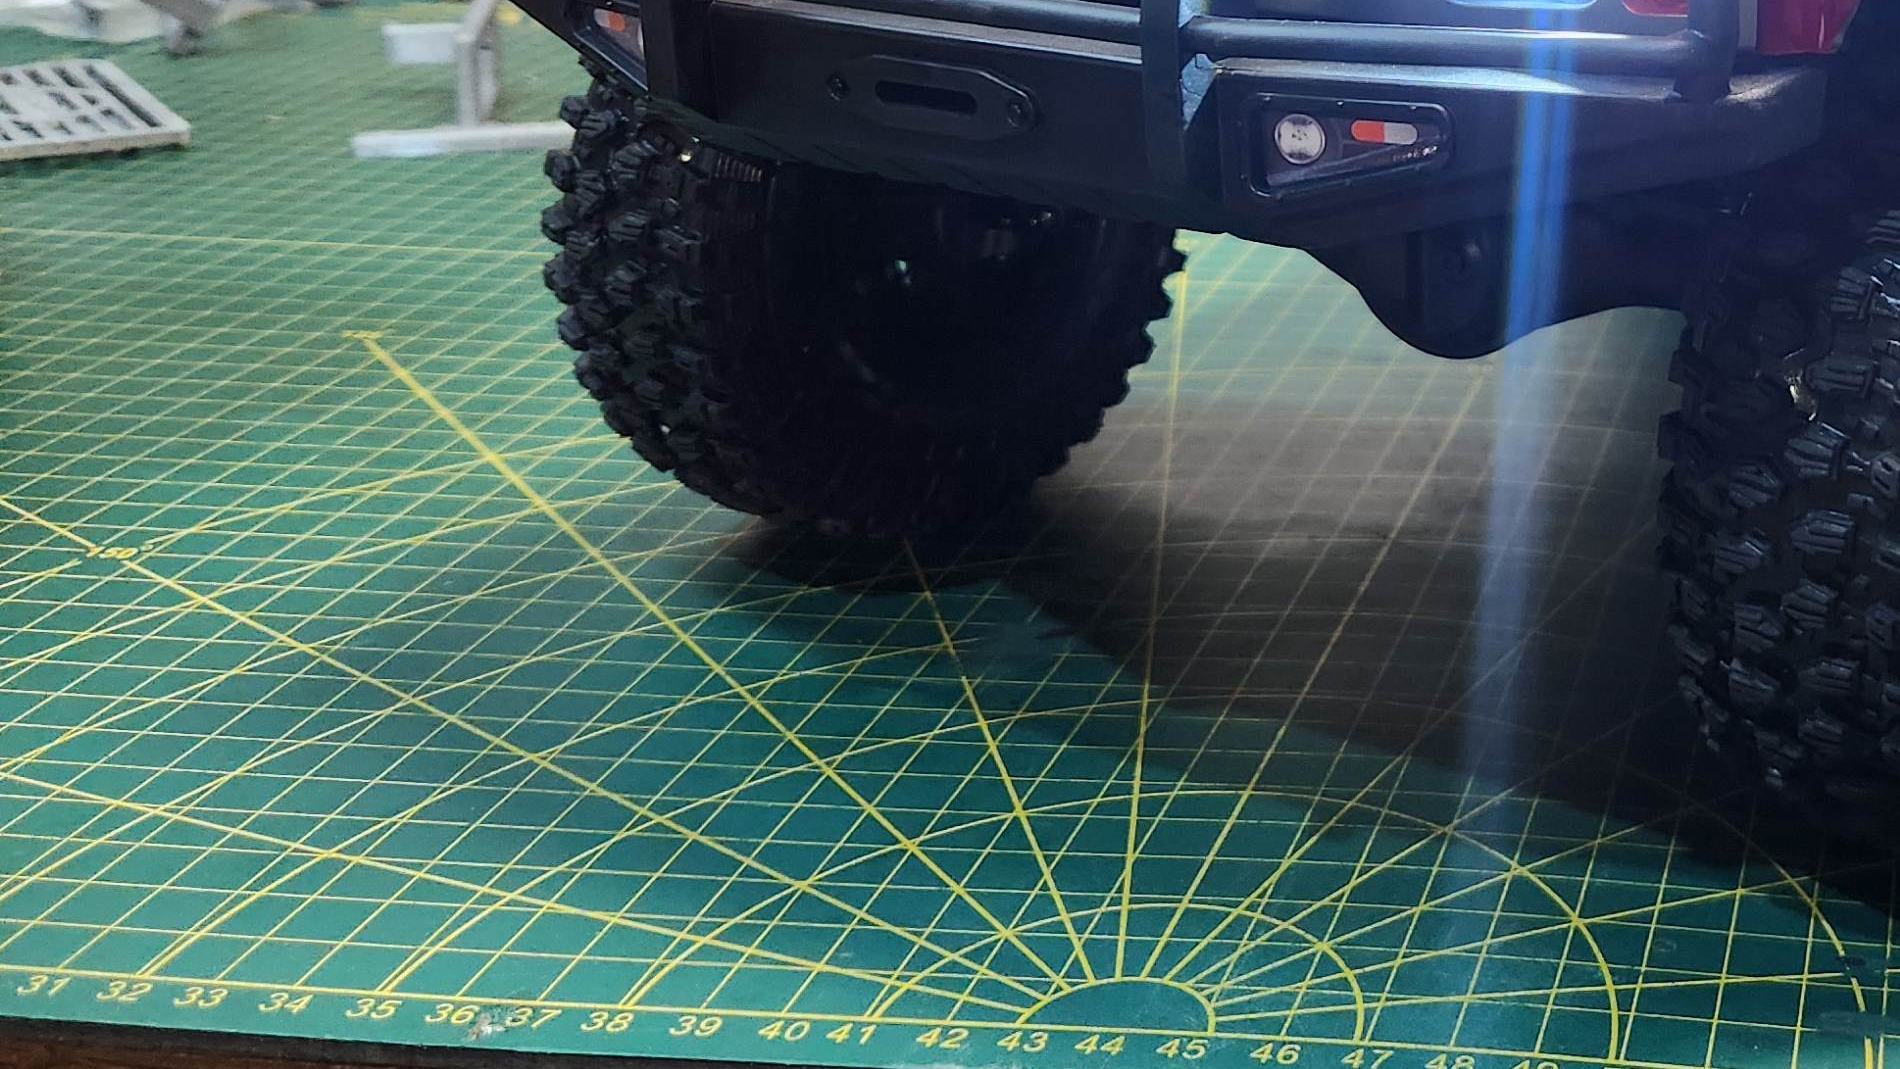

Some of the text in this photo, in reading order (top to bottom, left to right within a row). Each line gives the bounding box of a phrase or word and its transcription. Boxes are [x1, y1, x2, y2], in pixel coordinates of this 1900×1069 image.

[16, 974, 72, 996] 31
[96, 981, 153, 1002] 32
[173, 986, 229, 1008] 33
[258, 992, 314, 1015] 34
[346, 997, 402, 1020] 35
[424, 1003, 480, 1025] 36
[505, 1007, 563, 1029] 37
[580, 1011, 634, 1033] 38
[669, 1015, 723, 1037] 39
[758, 1020, 810, 1041] 40
[826, 1022, 877, 1045] 41
[916, 1027, 969, 1049] 42
[997, 1031, 1049, 1053] 43
[1074, 1034, 1125, 1056] 44
[1156, 1038, 1209, 1060] 45
[1250, 1042, 1301, 1065] 46
[1341, 1048, 1394, 1069] 47
